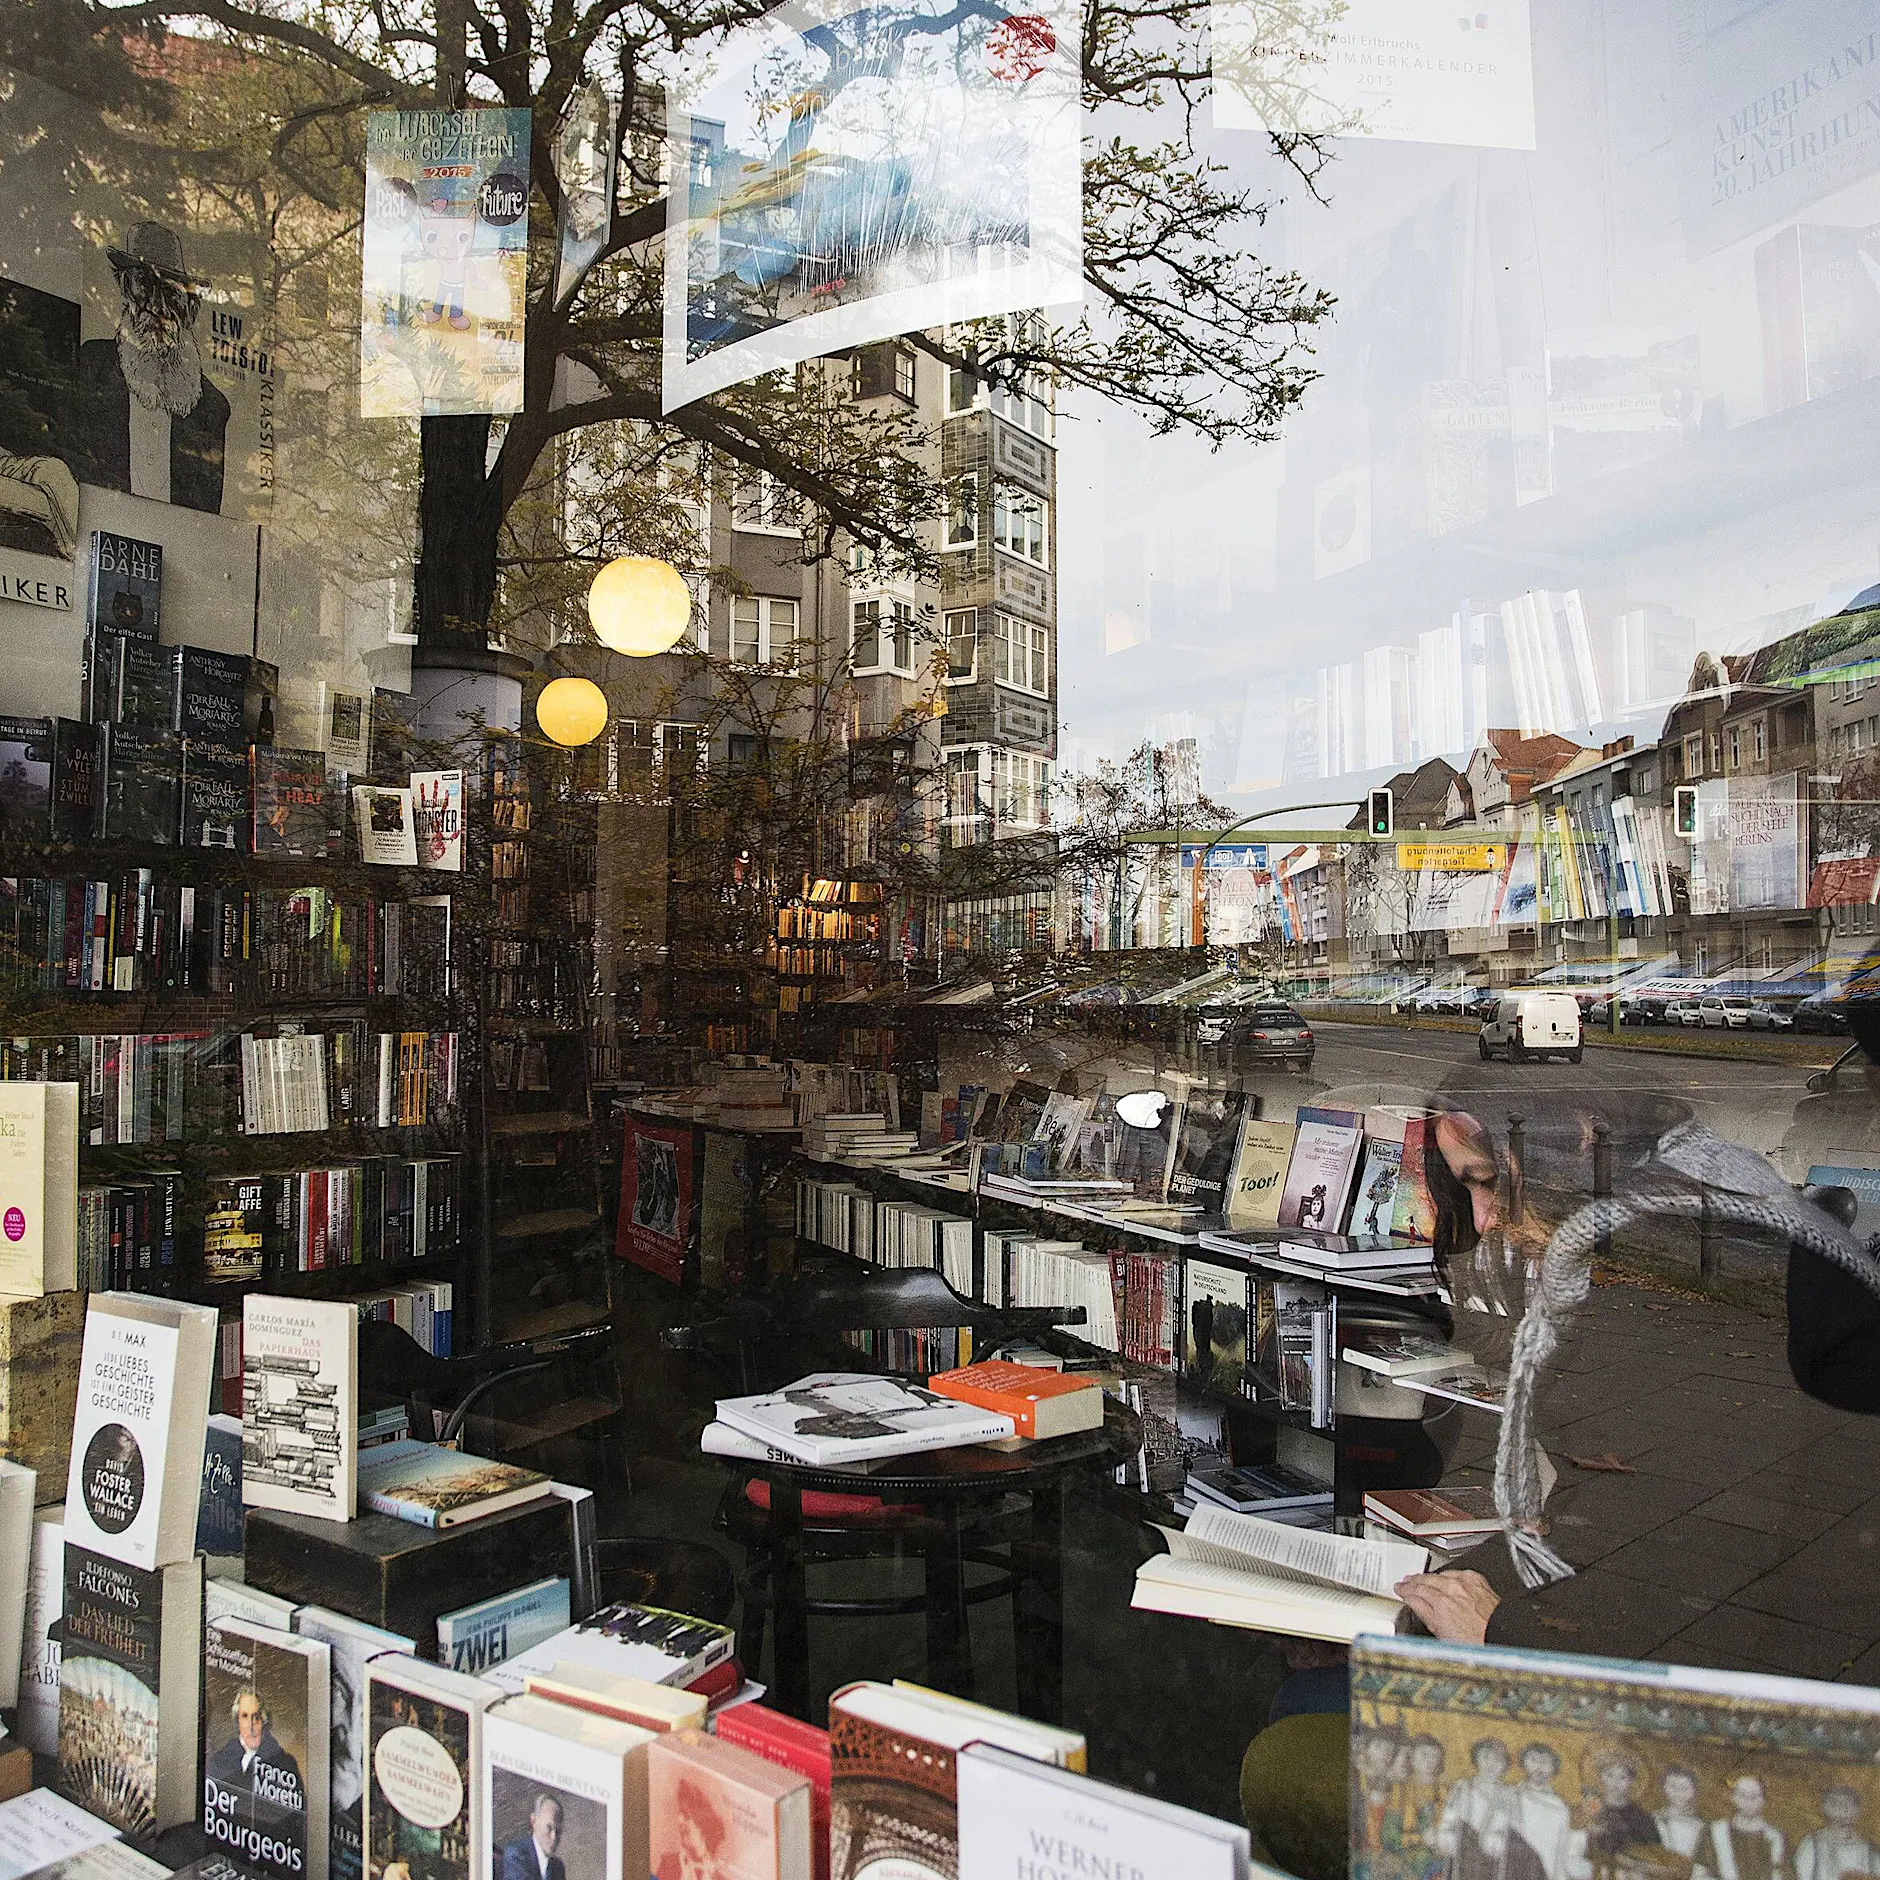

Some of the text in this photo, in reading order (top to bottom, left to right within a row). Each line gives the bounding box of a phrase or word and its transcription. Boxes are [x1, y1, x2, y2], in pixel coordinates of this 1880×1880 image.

[1328, 34, 1420, 51] Wolf Erlbruchs
[1356, 73, 1393, 87] 2015
[1711, 32, 1878, 150] AMERIKANI
[1711, 110, 1798, 178] KUNST
[430, 167, 466, 178] 2015
[376, 188, 407, 218] Past
[482, 184, 523, 217] Future
[212, 310, 242, 340] LEW
[259, 379, 274, 488] KLASSIKER
[100, 537, 159, 566] ARNE
[100, 553, 160, 582] DAHL
[103, 625, 153, 641] Der elfte Gast
[130, 646, 154, 660] Volker
[189, 654, 228, 669] ANTHONY
[204, 665, 243, 684] HOROWITZ
[209, 693, 231, 711] FALL
[188, 705, 241, 728] MORIARTY
[1, 726, 15, 734] TAGE
[26, 727, 47, 736] BEIRUT
[114, 730, 139, 742] Volker
[207, 753, 246, 769] HOROWITZ
[191, 793, 245, 815] MORIARTY
[1757, 795, 1777, 807] DER
[1764, 804, 1794, 819] NACH
[1740, 817, 1789, 833] DER SEELE
[1735, 832, 1773, 847] BERLINS
[137, 895, 146, 937] EDWARDSON
[224, 903, 233, 957] ESCHBACH
[341, 1088, 349, 1110] LANG
[1372, 1145, 1392, 1158] Walter
[239, 1186, 262, 1199] GIFT
[1171, 1183, 1196, 1195] PLANET
[1173, 1174, 1222, 1192] DER GEDULDIGE
[1240, 1171, 1280, 1193] Toor!
[164, 1182, 173, 1236] ERWARTUNG
[238, 1199, 262, 1211] AFFE
[8, 1213, 21, 1222] NEU
[1193, 1273, 1222, 1286] NATURSCHUTZ
[1198, 1282, 1227, 1295] DEUTSCHLAND
[248, 1312, 316, 1329] CARLOS MARÍA
[249, 1323, 303, 1337] DOMÍNGUEZ
[124, 1332, 147, 1348] MAX
[259, 1342, 322, 1358] PAPIERHAUS
[302, 1337, 321, 1348] DAS
[119, 1354, 149, 1373] LIEBES
[95, 1363, 154, 1390] GESCHICHTE
[117, 1384, 155, 1406] GEISTER
[91, 1393, 151, 1420] GESCHICHTE
[95, 1469, 131, 1494] FOSTER
[89, 1483, 134, 1511] WALLACE
[93, 1502, 126, 1522] EIN LEBEN
[86, 1561, 133, 1588] ILDEFONSO
[78, 1571, 140, 1609] FALCONES
[81, 1602, 135, 1637] DAS LIED
[68, 1613, 147, 1661] DER FREIHEIT
[453, 1624, 508, 1672] ZWEI
[254, 1756, 297, 1788] Franco
[490, 1750, 611, 1800] BERNARD VON BRENTANO
[204, 1779, 238, 1816] Der
[254, 1779, 303, 1810] Moretti
[204, 1806, 303, 1872] Bourgeois
[1029, 1829, 1143, 1880] WERNER
